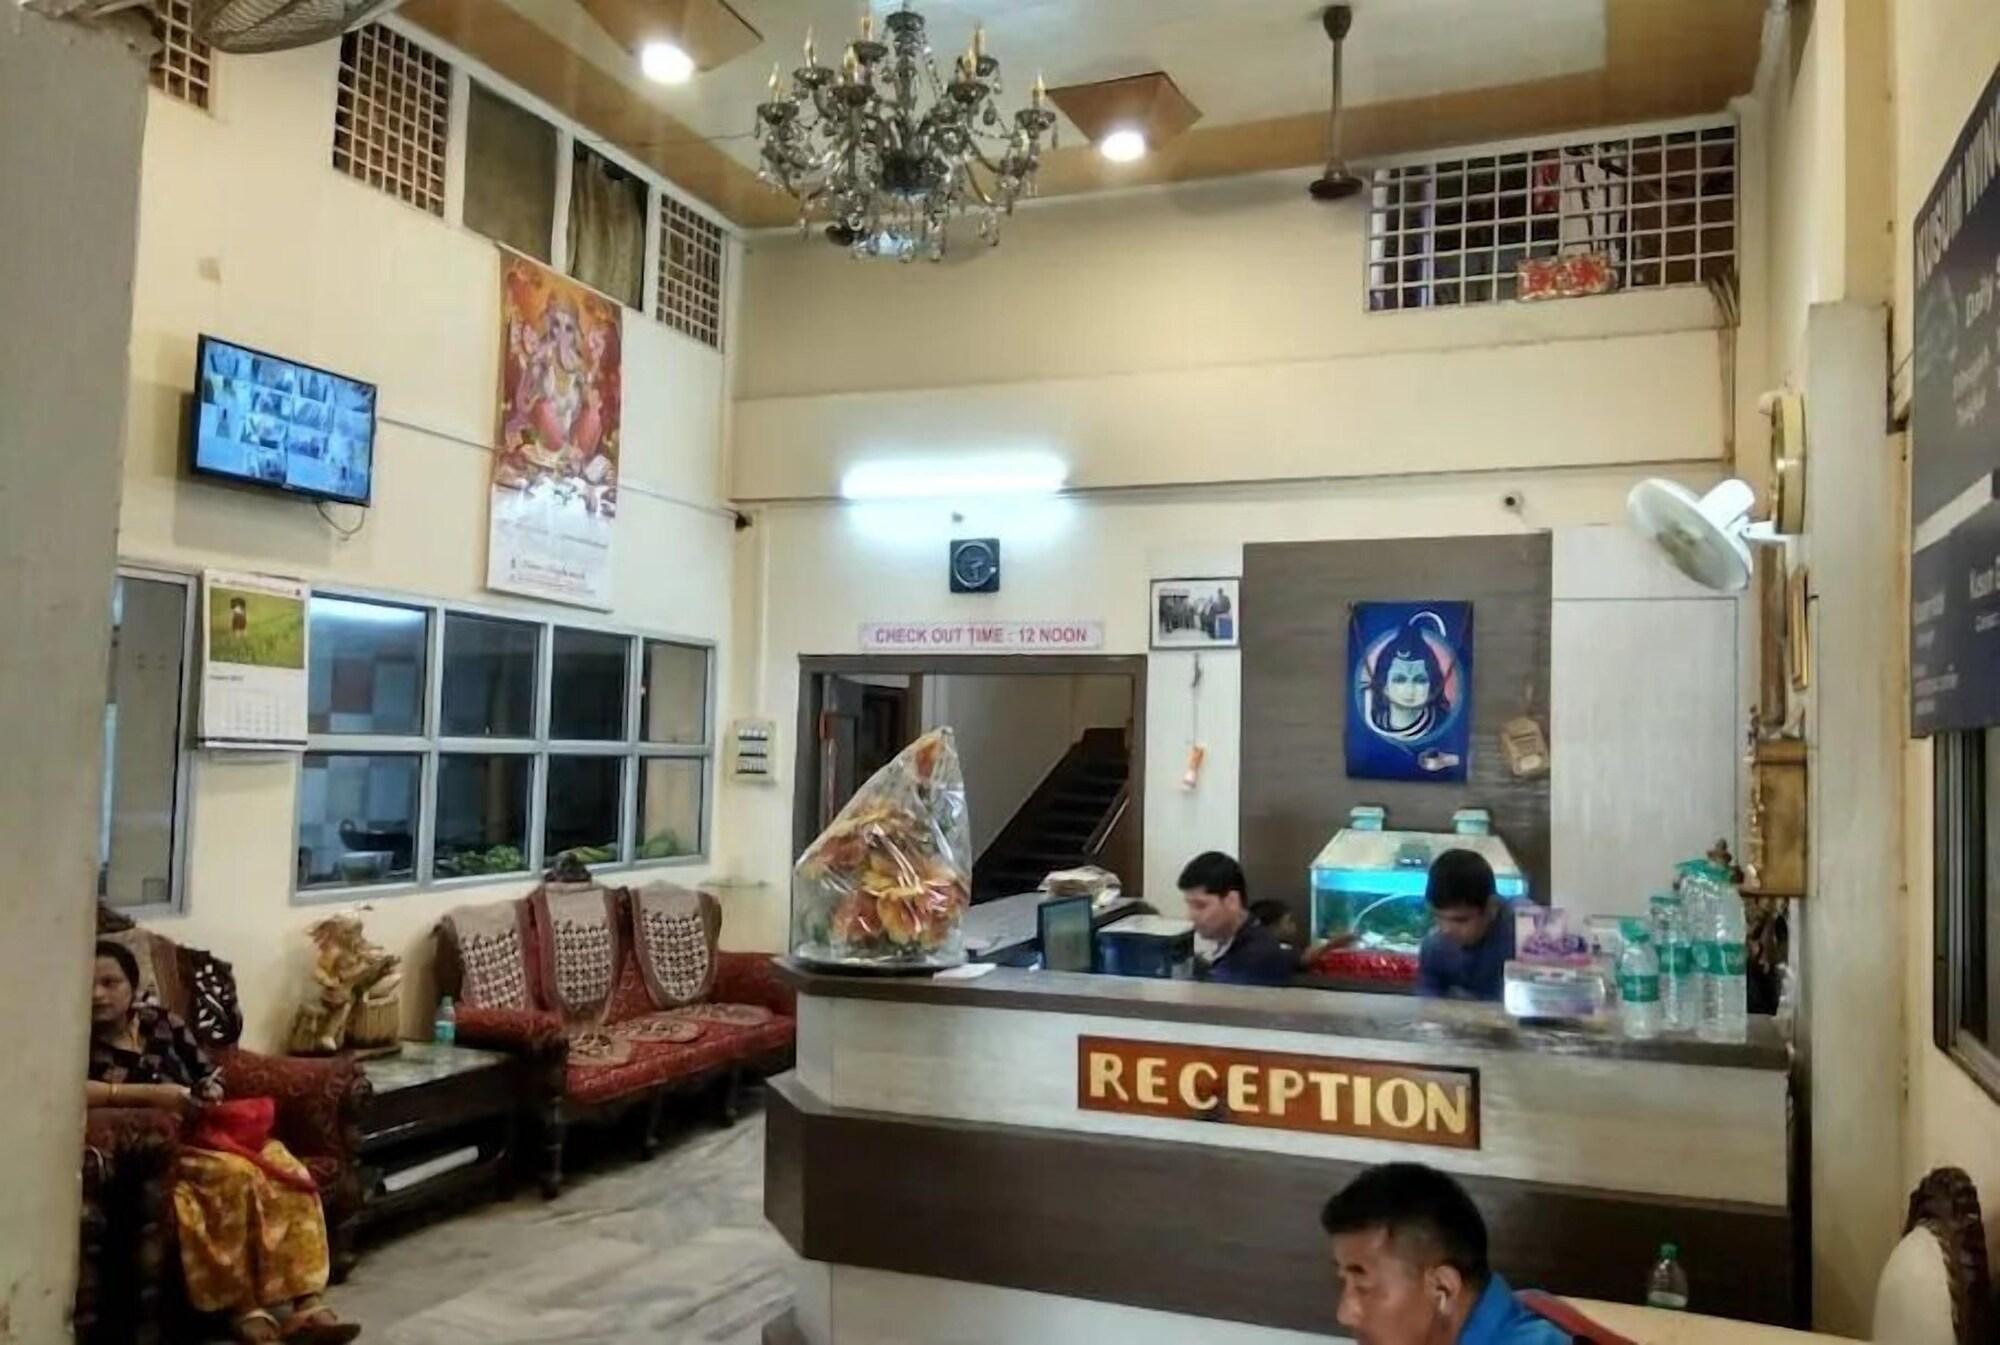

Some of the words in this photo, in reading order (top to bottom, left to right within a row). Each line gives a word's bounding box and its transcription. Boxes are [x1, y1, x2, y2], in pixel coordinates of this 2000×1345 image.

[875, 627, 927, 643] CHECK
[931, 627, 962, 643] OUT
[969, 626, 1003, 643] TIME
[1018, 627, 1035, 642] 12
[1039, 627, 1087, 642] NOON
[1088, 1051, 1467, 1134] RECEPTION
